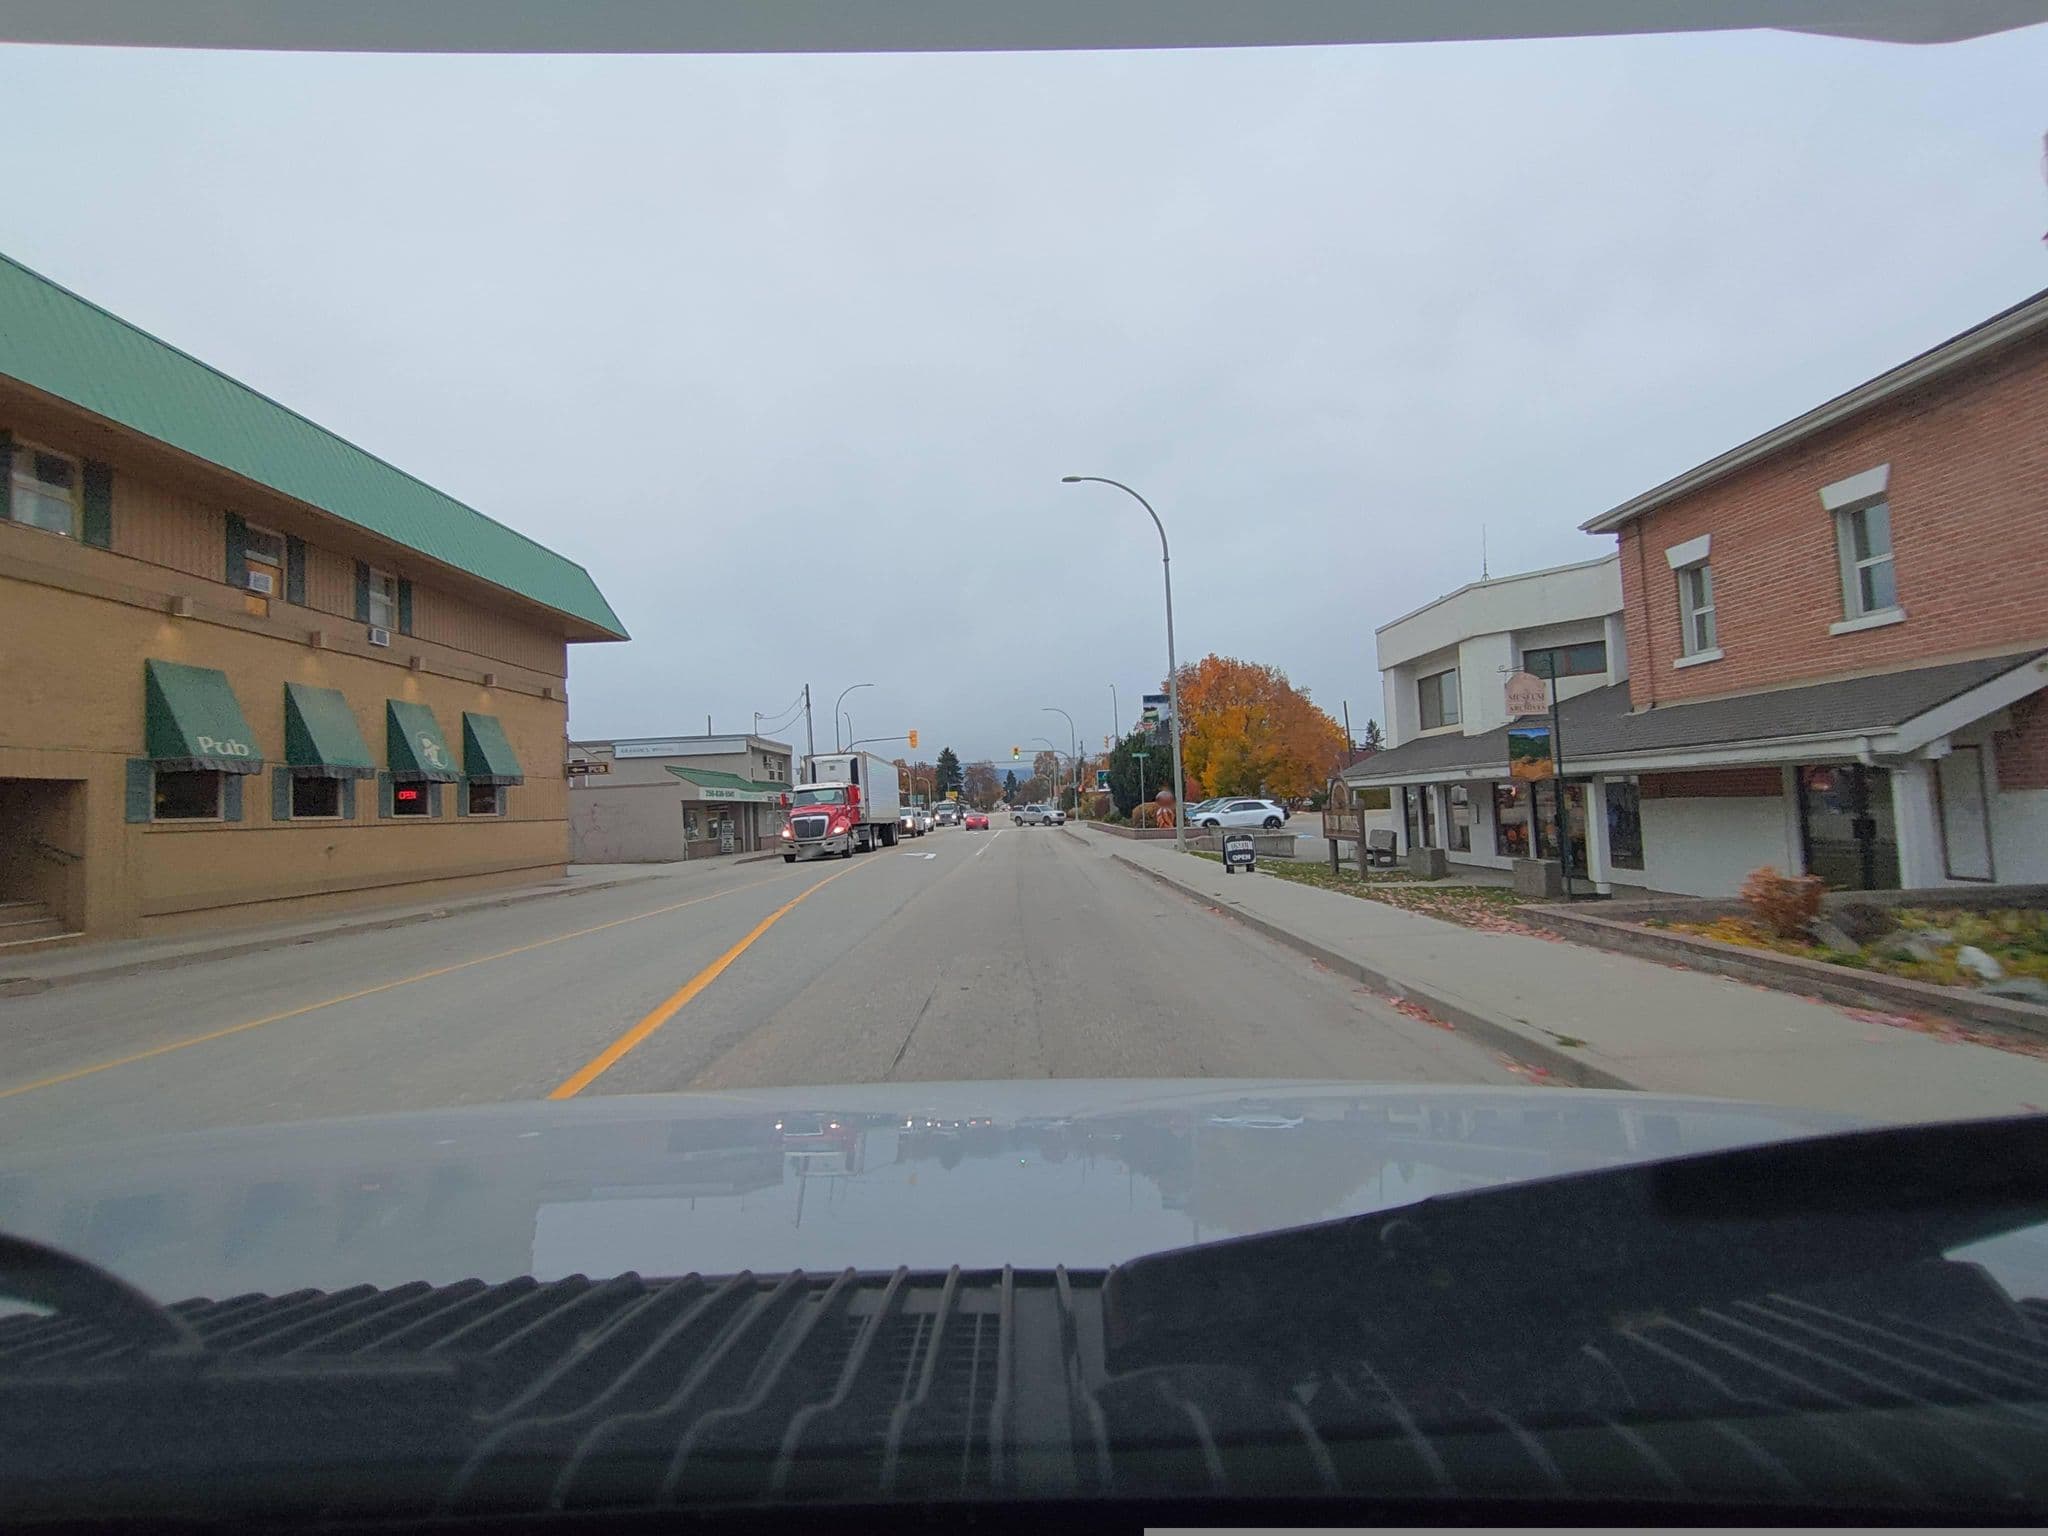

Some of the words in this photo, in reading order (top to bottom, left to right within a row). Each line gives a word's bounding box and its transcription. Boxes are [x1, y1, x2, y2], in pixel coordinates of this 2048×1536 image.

[1508, 693, 1545, 701] MUSEUM
[197, 736, 249, 756] Pub
[398, 790, 417, 800] OPEN
